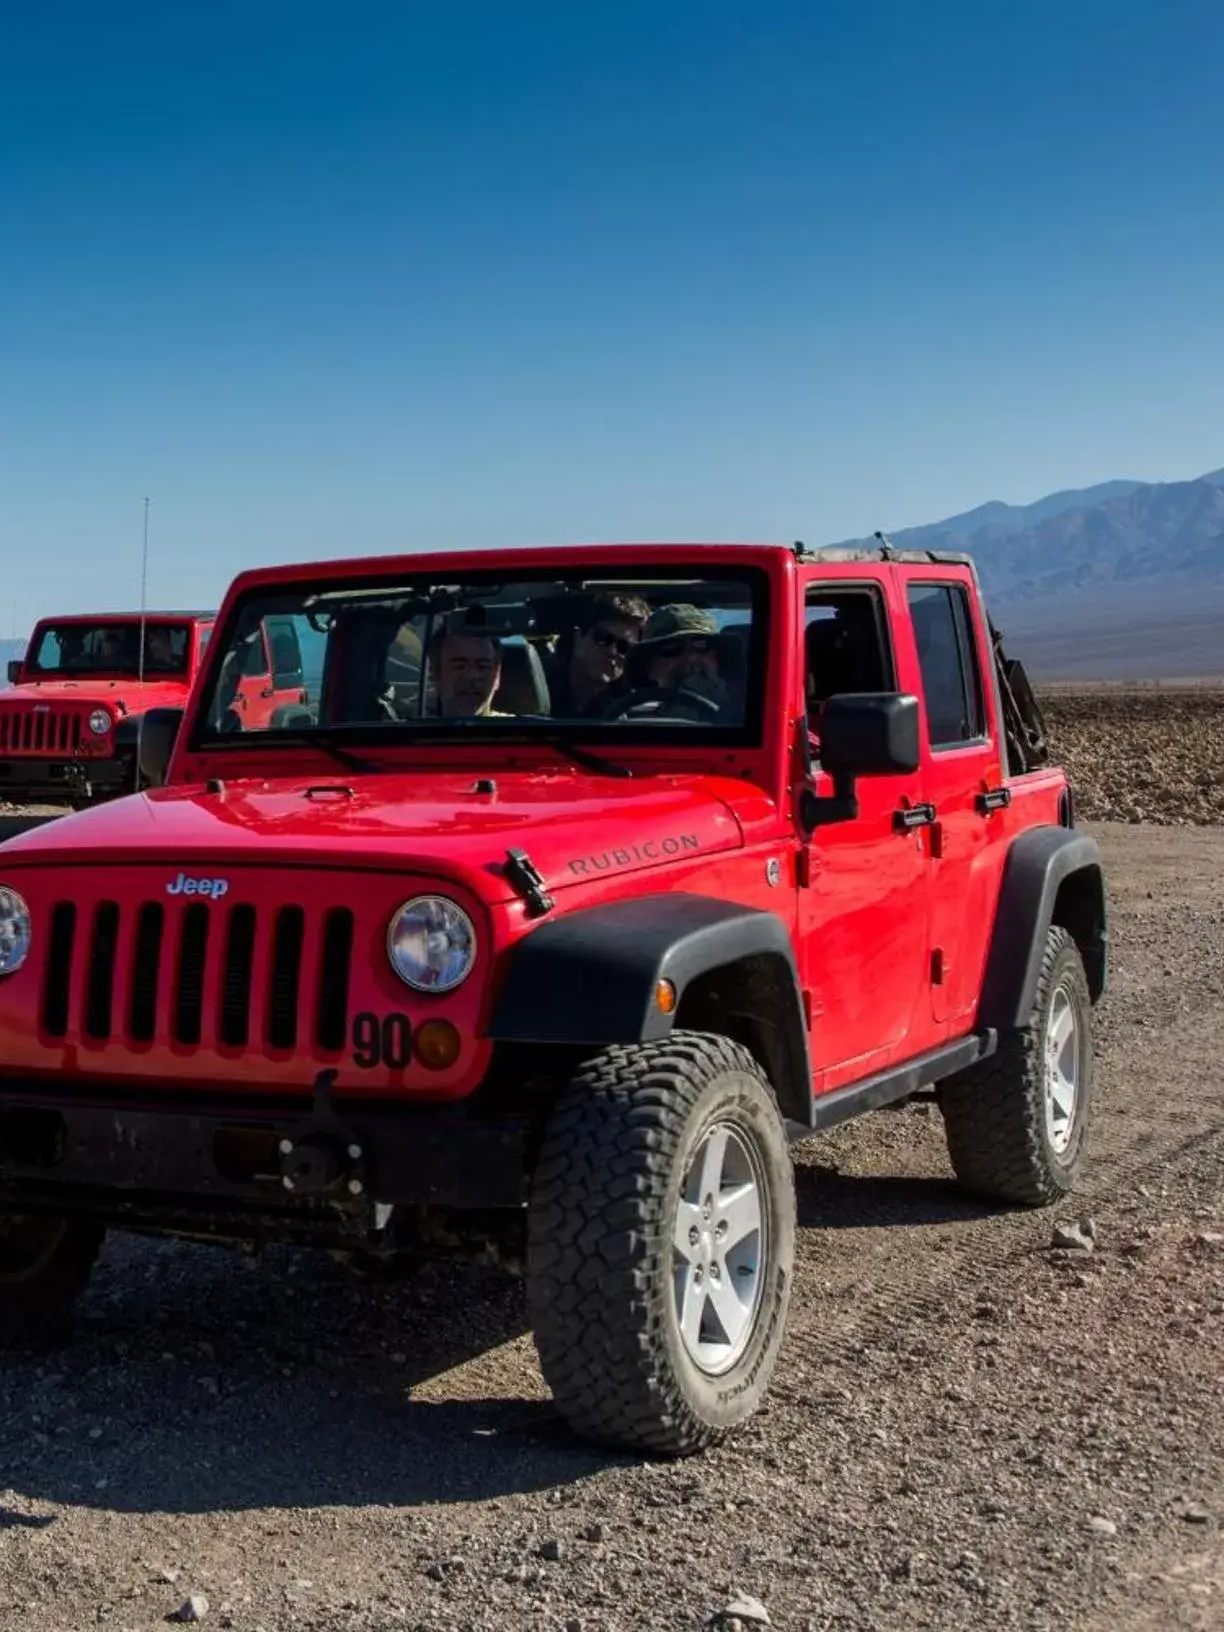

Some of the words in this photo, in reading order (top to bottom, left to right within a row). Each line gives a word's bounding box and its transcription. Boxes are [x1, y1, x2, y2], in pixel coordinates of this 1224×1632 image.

[568, 834, 698, 876] RUBICON
[167, 873, 228, 899] Jeep
[353, 1011, 413, 1070] 90
